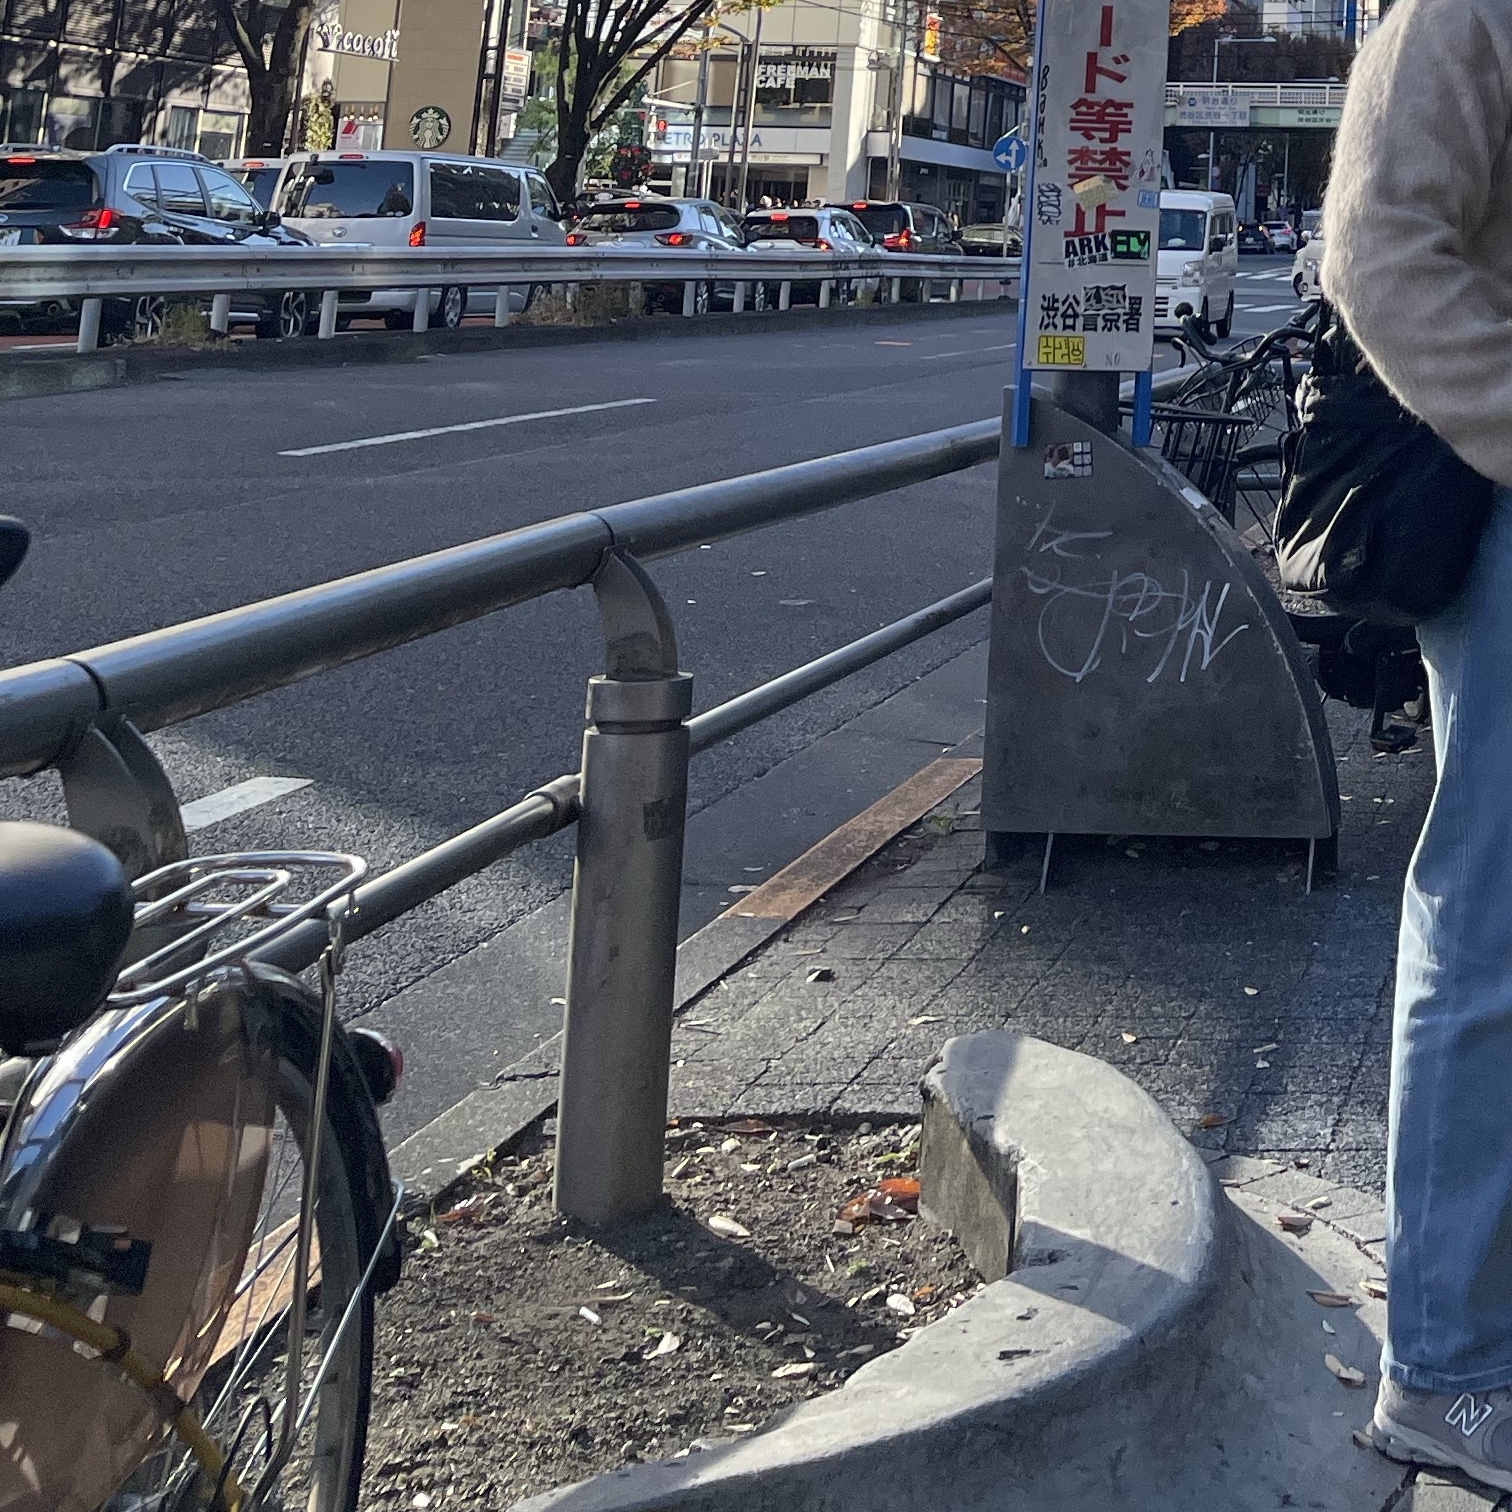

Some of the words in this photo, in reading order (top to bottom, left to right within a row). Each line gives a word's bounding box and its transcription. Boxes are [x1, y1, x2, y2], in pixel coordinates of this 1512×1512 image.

[758, 63, 832, 79] FREEMAN
[756, 76, 796, 89] CAFE
[712, 133, 763, 147] PLAA
[1065, 232, 1110, 259] ARK
[1444, 1392, 1493, 1437] N
